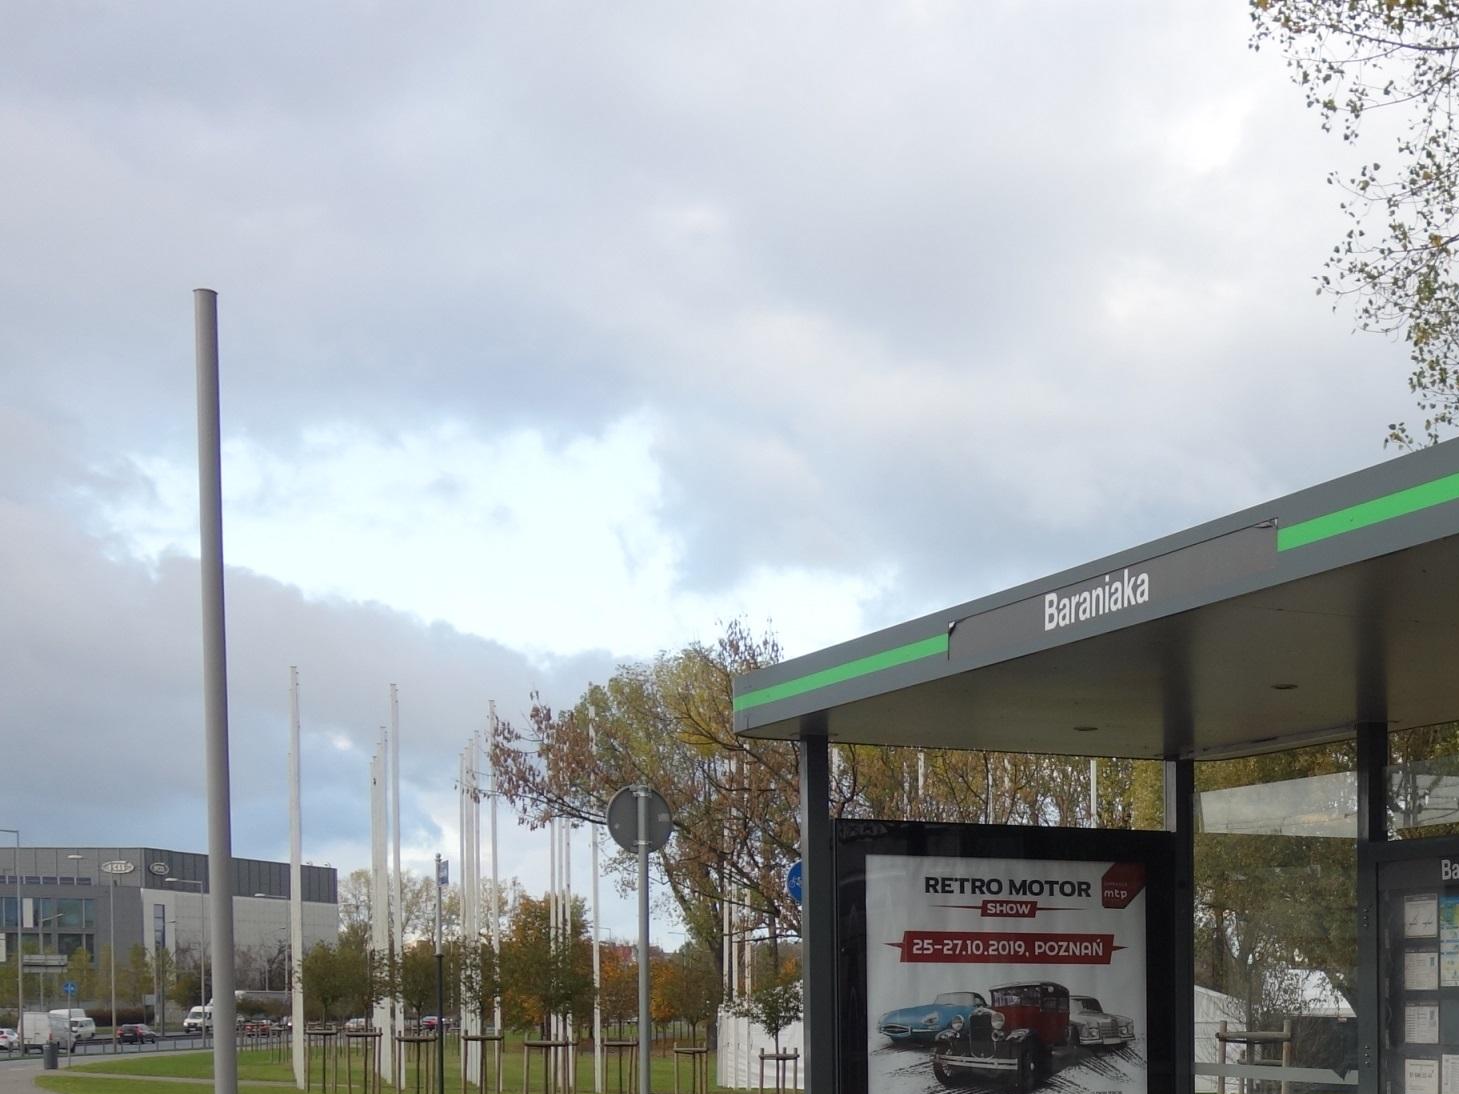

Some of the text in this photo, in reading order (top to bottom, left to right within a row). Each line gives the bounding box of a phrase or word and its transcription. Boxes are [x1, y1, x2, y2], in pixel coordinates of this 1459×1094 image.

[1044, 568, 1149, 632] Baraniaka
[924, 876, 1092, 898] RETRO MOTOR
[1103, 888, 1128, 900] mtp
[986, 902, 1031, 915] SHOW
[912, 938, 1103, 957] 25-27.10.2019, POZNAŃ
